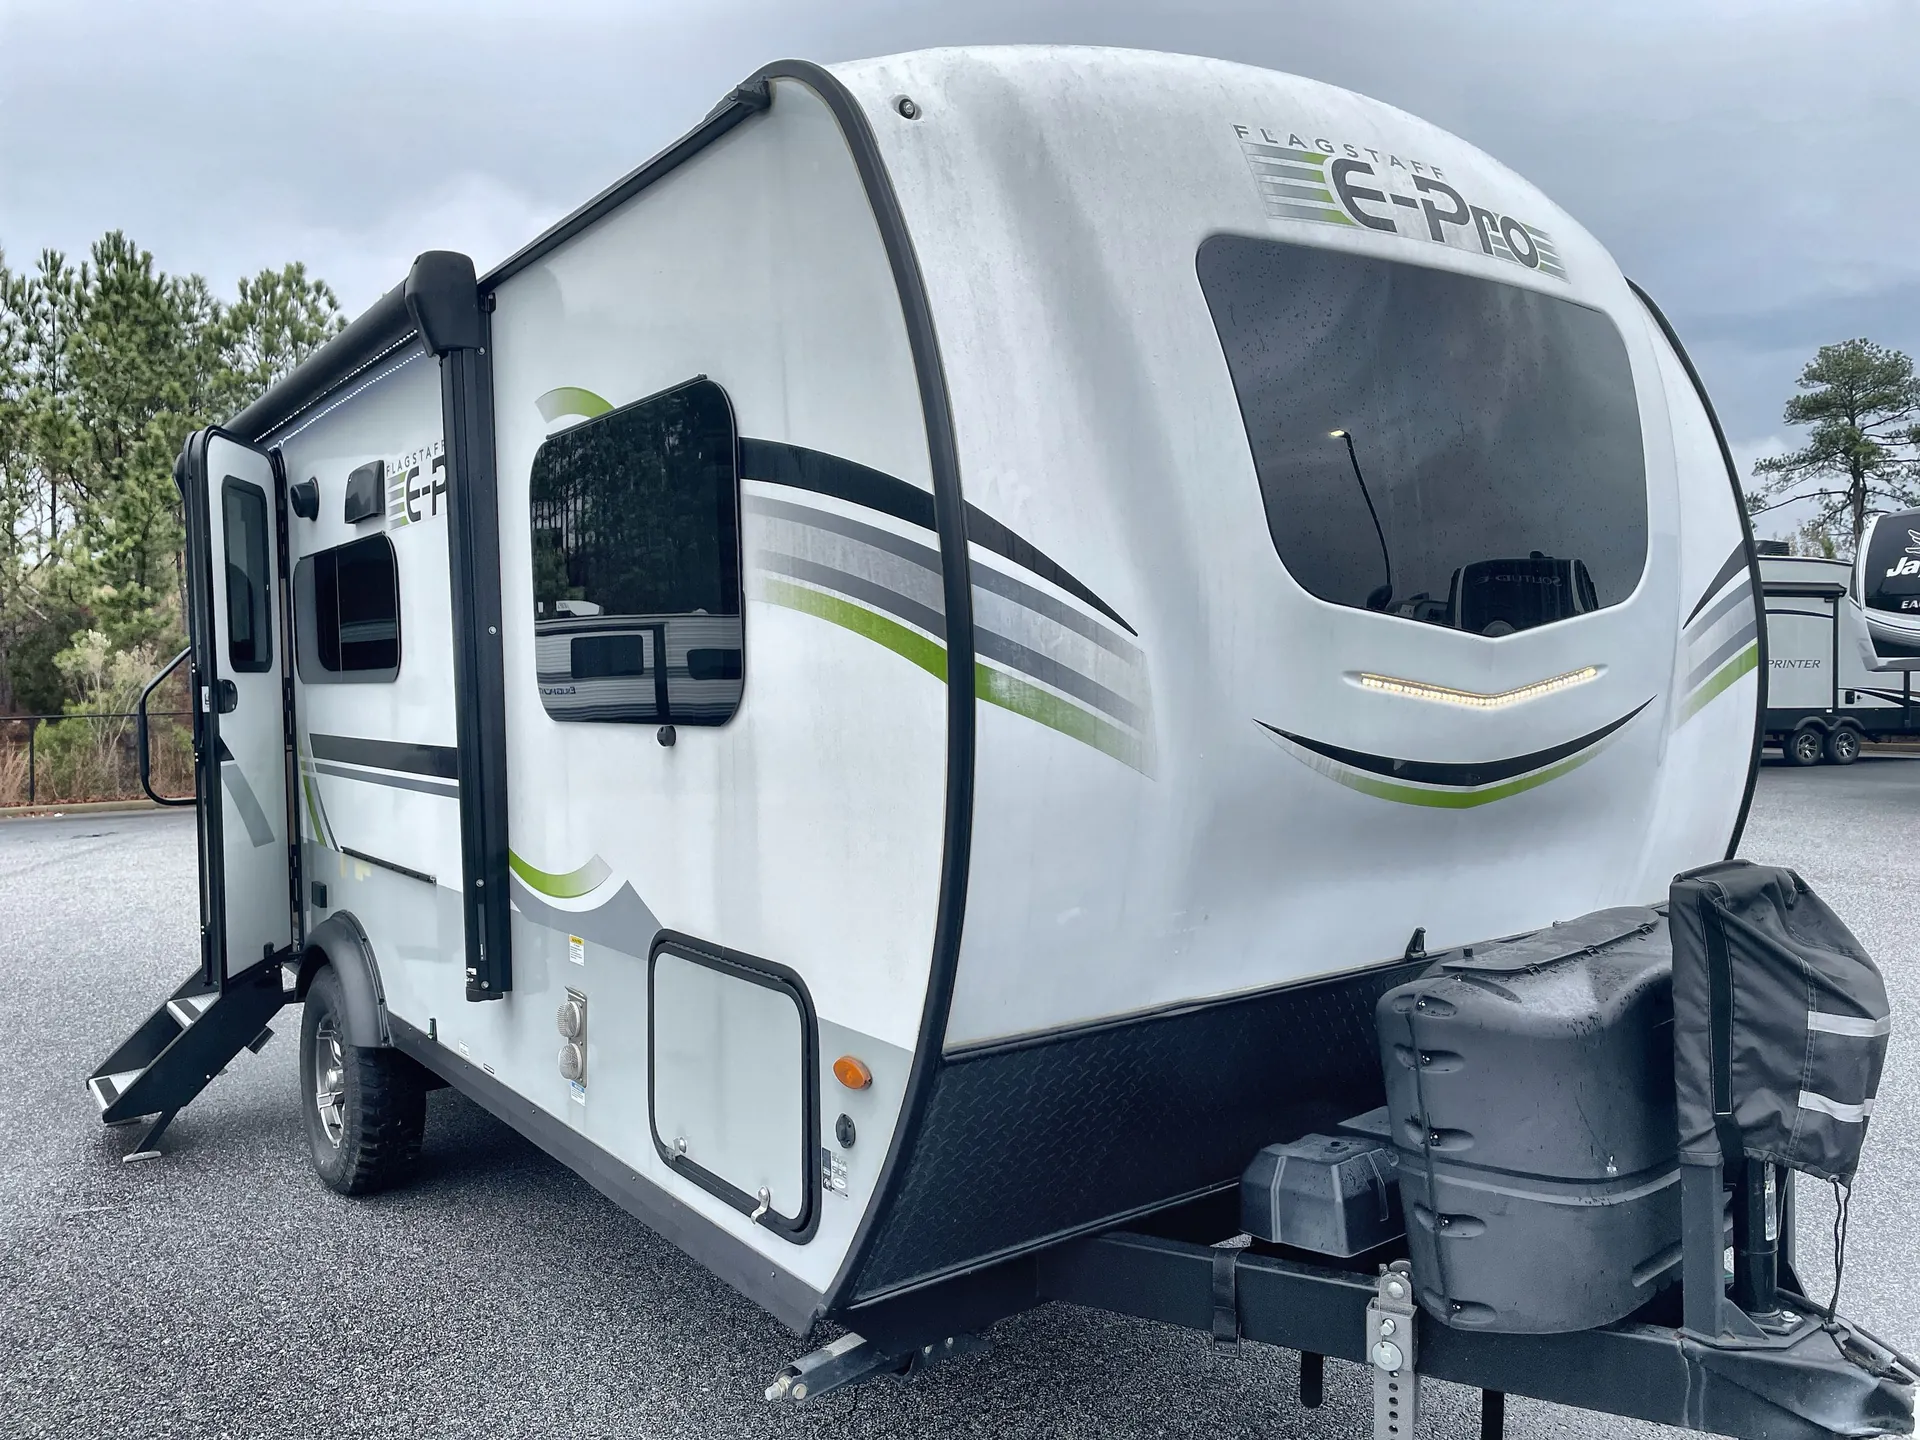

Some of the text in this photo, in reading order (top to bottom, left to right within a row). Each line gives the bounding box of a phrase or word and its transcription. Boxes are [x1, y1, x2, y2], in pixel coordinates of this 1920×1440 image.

[1233, 124, 1444, 179] FLAGSTAFF
[1331, 158, 1540, 269] E-Pro
[1886, 556, 1920, 578] Ja
[1901, 600, 1920, 609] EA
